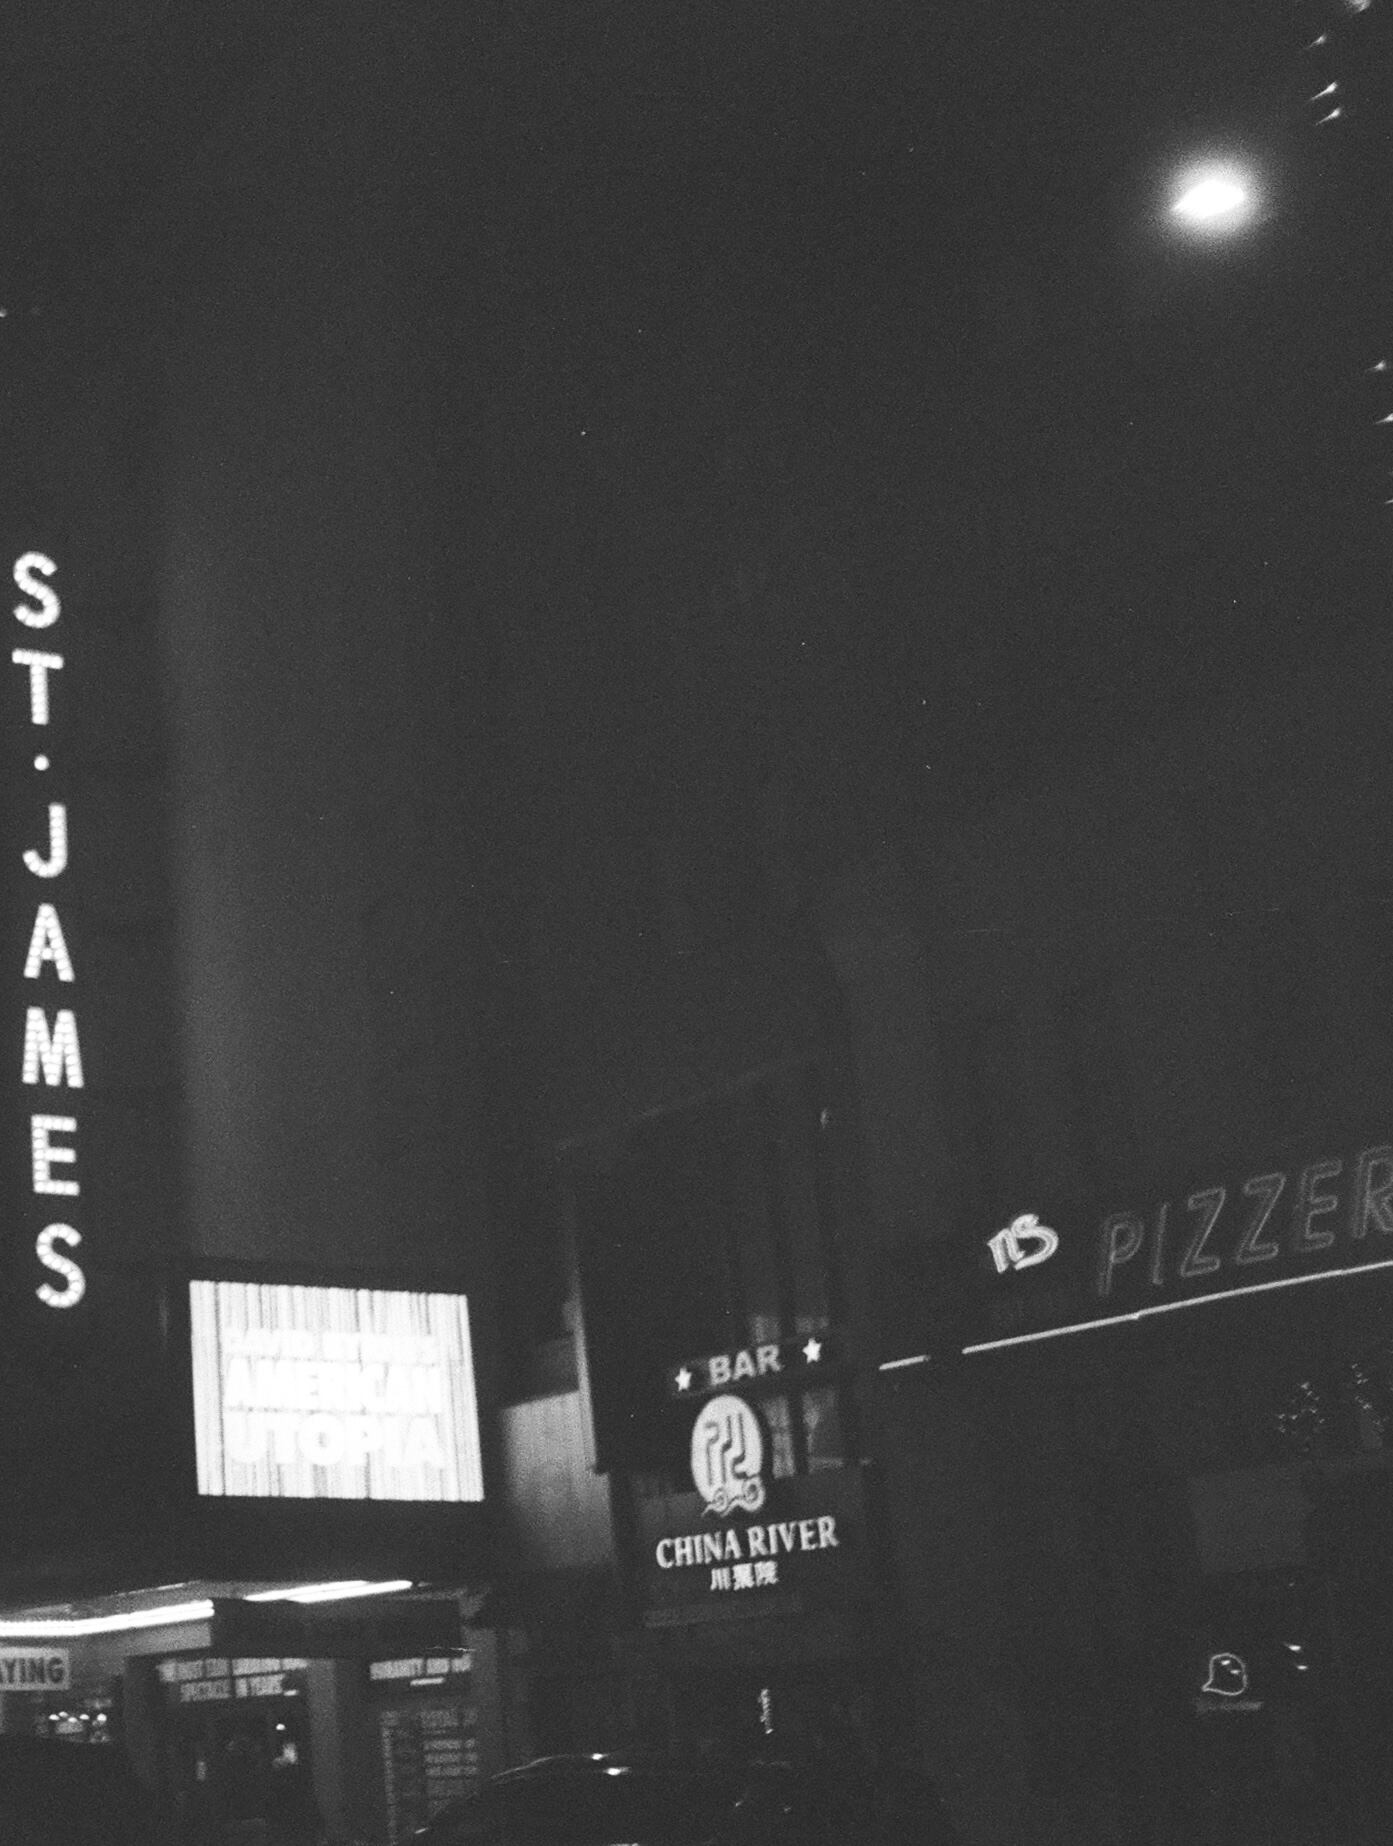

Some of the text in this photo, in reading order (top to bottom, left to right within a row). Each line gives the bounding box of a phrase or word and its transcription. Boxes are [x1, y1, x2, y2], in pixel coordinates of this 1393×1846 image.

[21, 802, 87, 1310] JAMES
[707, 1343, 784, 1387] BAR
[225, 1413, 447, 1467] UTOPIA
[655, 1515, 840, 1570] CHINA RIVER
